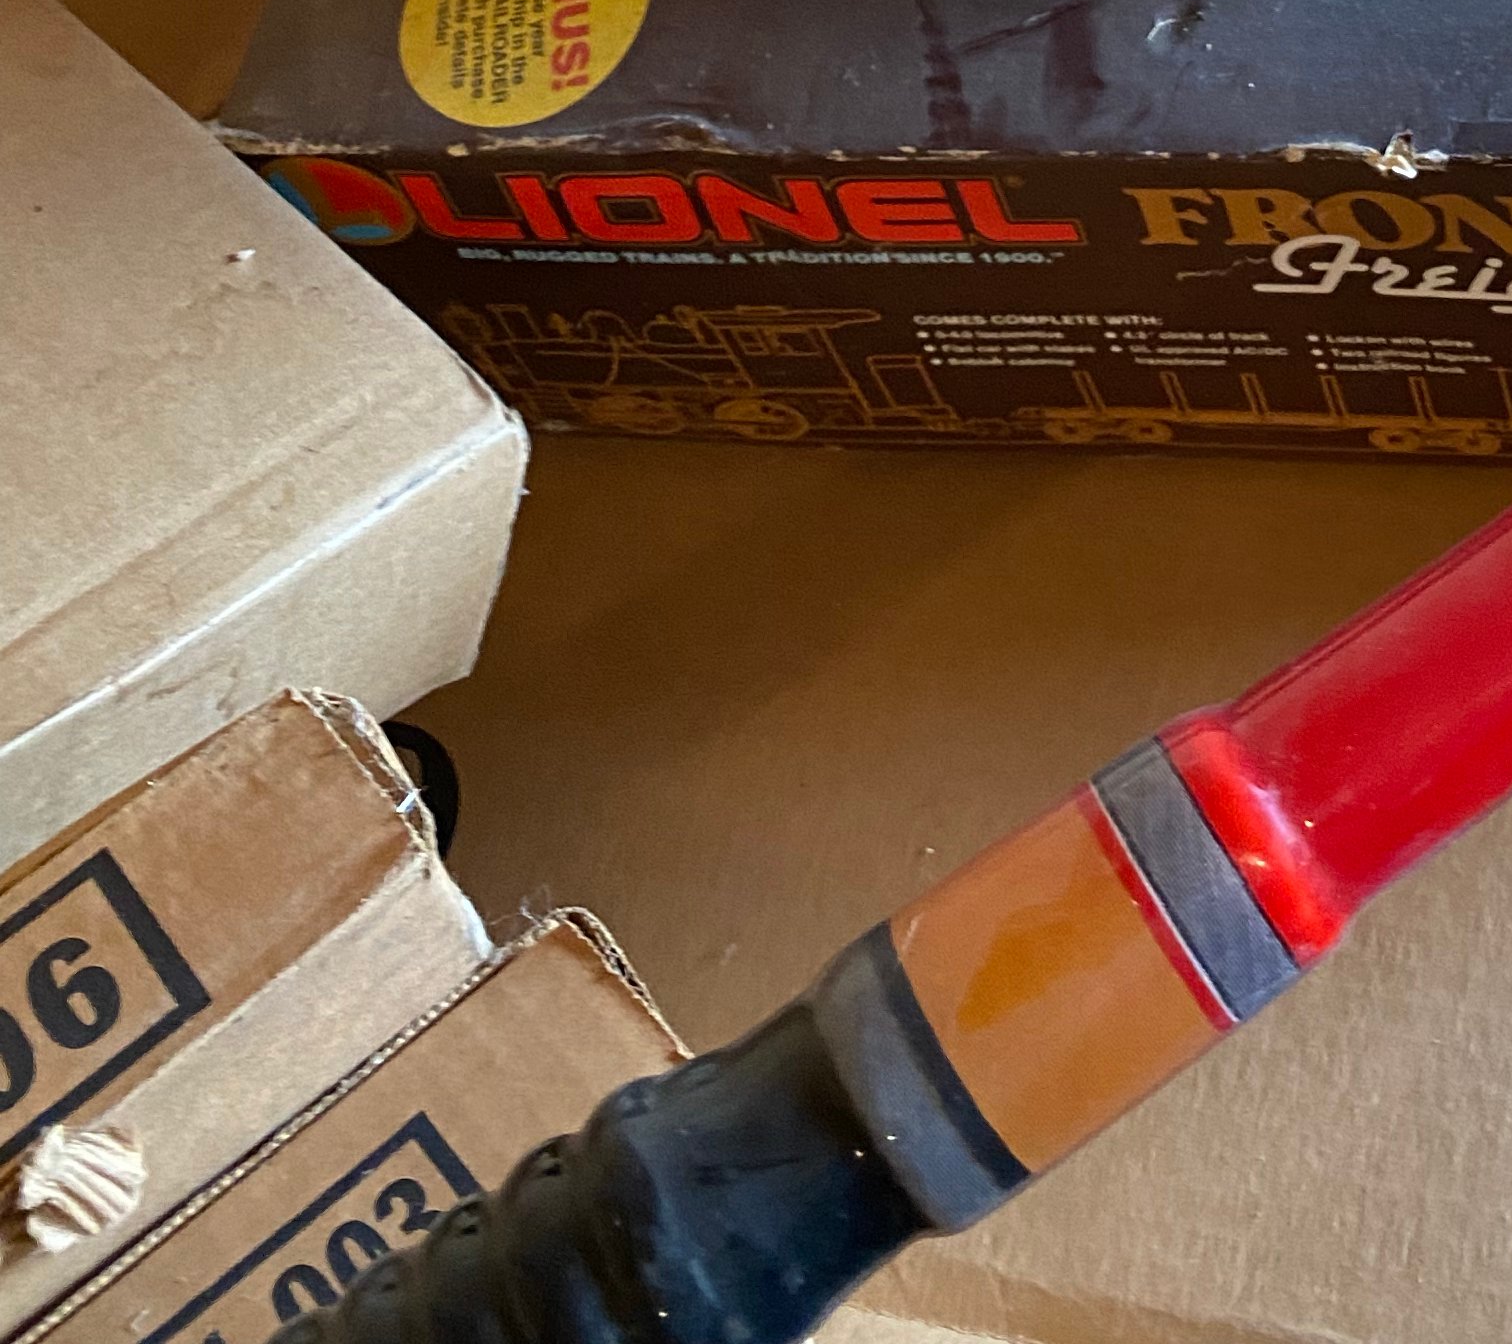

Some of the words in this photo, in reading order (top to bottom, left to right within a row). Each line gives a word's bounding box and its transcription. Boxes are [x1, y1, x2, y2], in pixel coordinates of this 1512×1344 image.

[528, 18, 548, 57] year
[510, 55, 529, 86] the
[400, 173, 1084, 243] LIONEL
